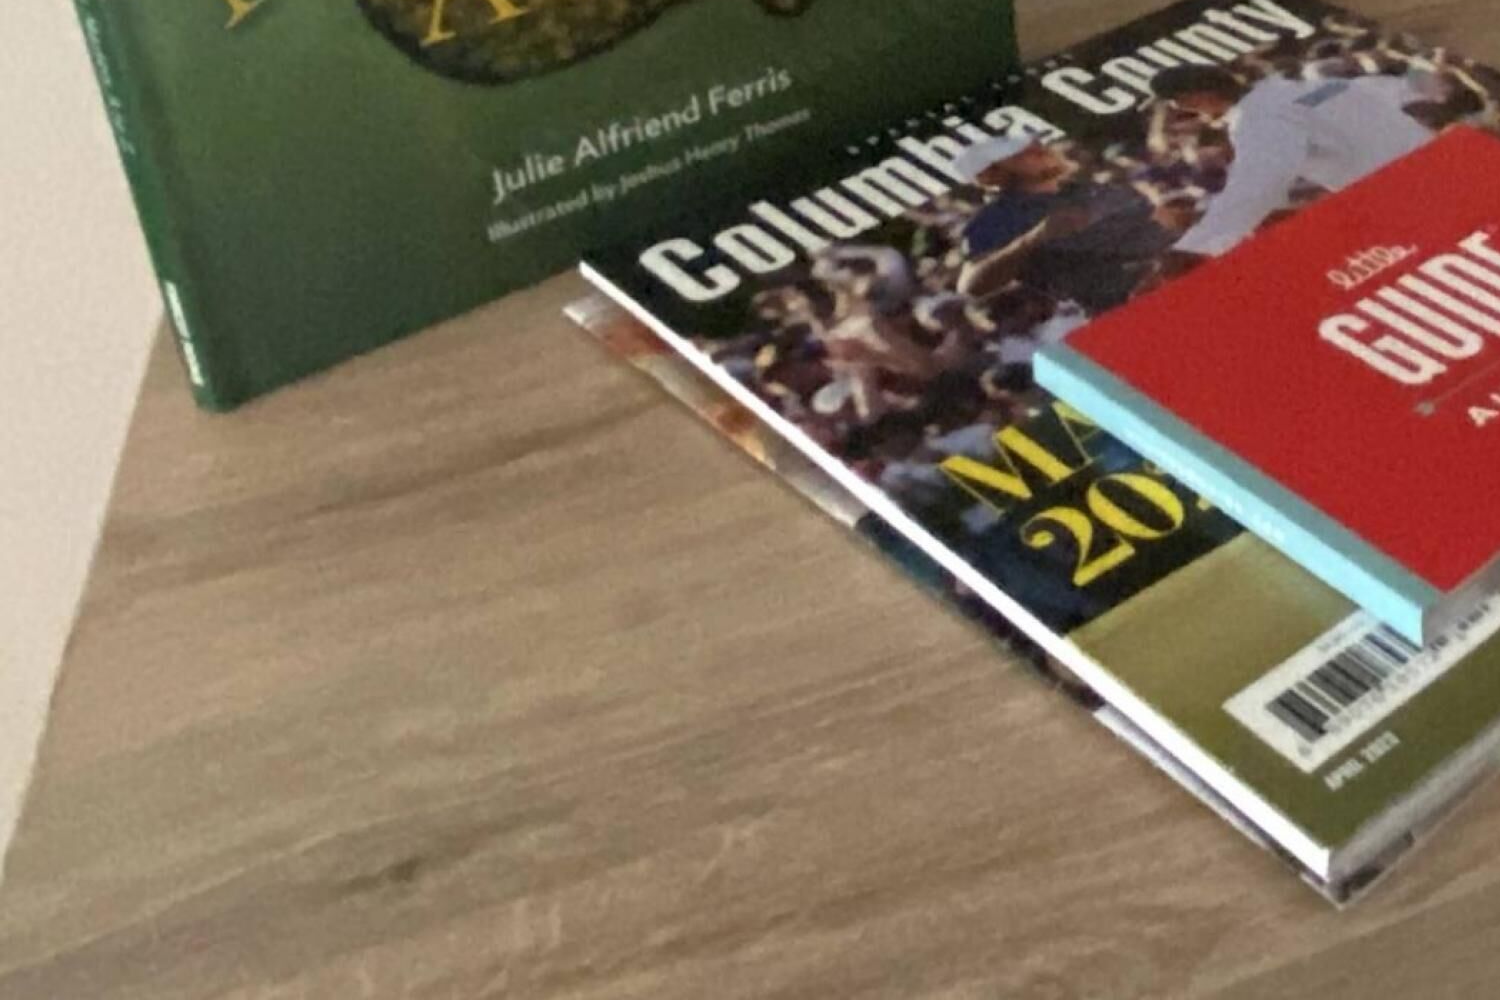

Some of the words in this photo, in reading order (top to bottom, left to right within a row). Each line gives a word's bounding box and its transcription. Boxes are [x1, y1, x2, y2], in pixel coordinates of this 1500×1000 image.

[491, 150, 565, 205] Julie
[574, 95, 701, 167] Alfriend
[707, 66, 792, 116] Ferris
[638, 105, 1066, 304] Columbia
[1020, 473, 1212, 587] 20
